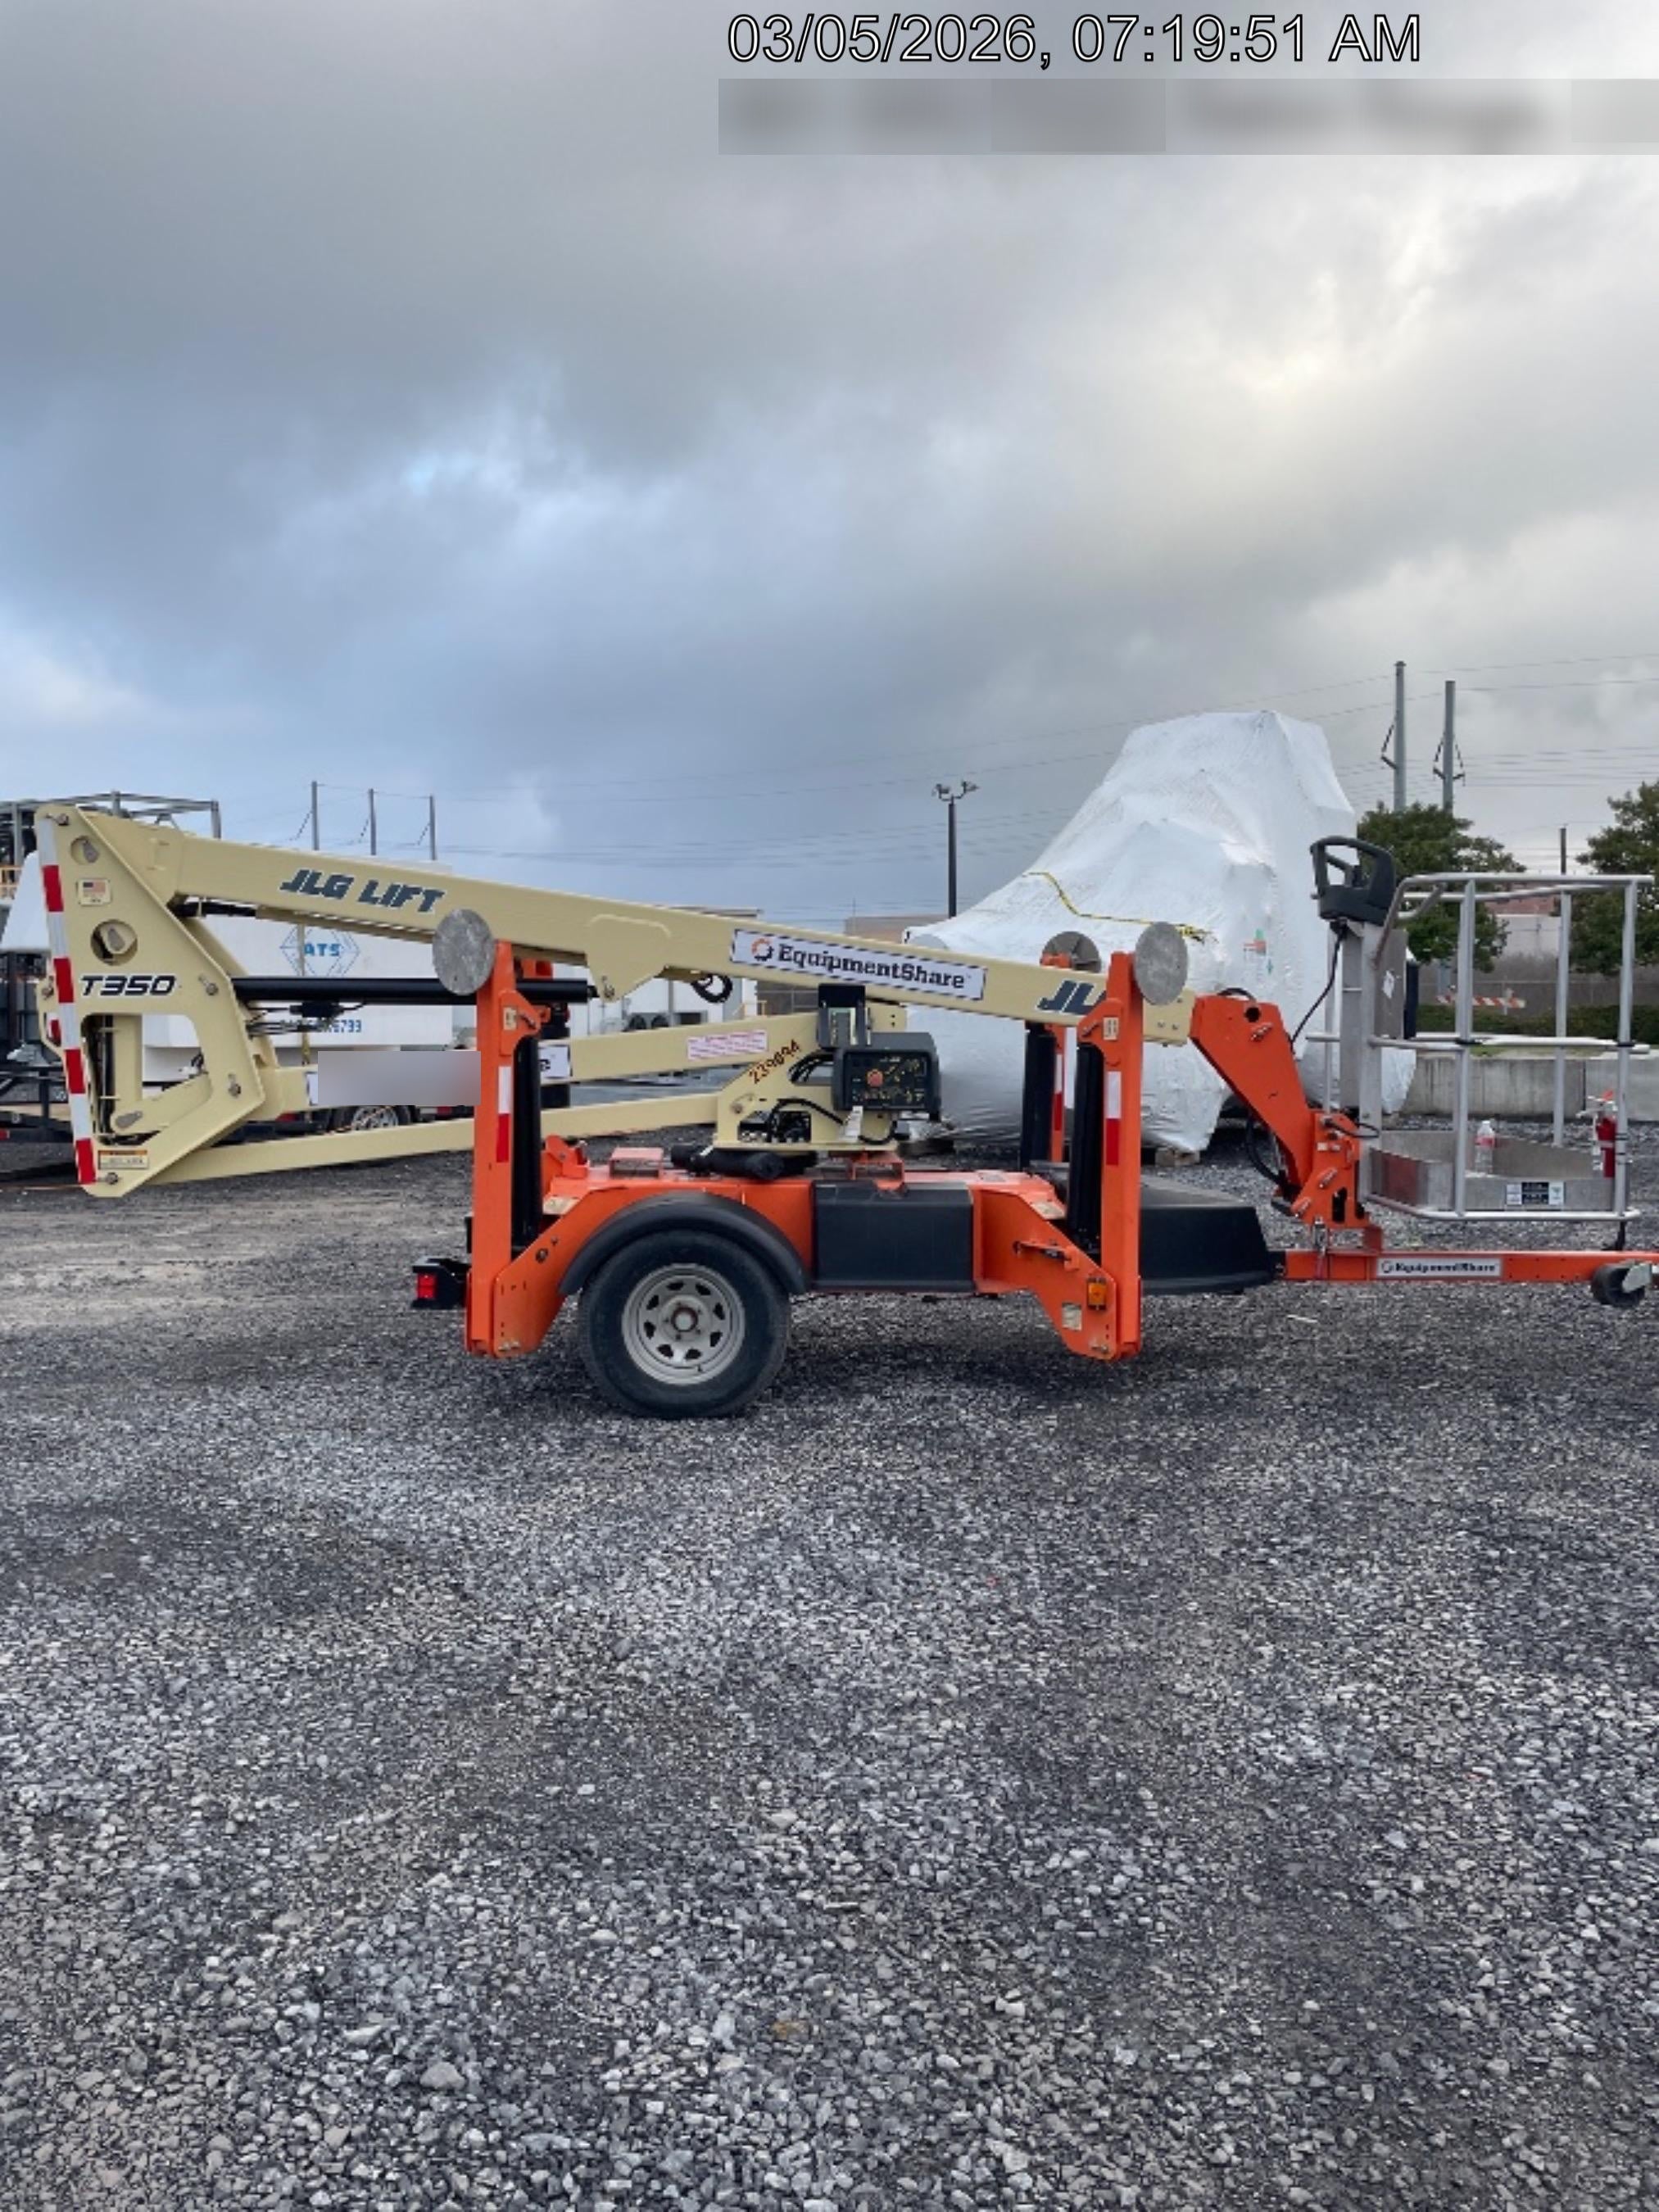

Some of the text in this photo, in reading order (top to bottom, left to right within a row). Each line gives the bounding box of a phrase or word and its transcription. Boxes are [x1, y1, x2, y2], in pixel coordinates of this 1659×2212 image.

[279, 868, 446, 913] JLG LIFT
[303, 943, 342, 957] ATS
[777, 943, 965, 989] EquipmentShare
[80, 975, 177, 996] T350
[1036, 979, 1107, 1015] JL
